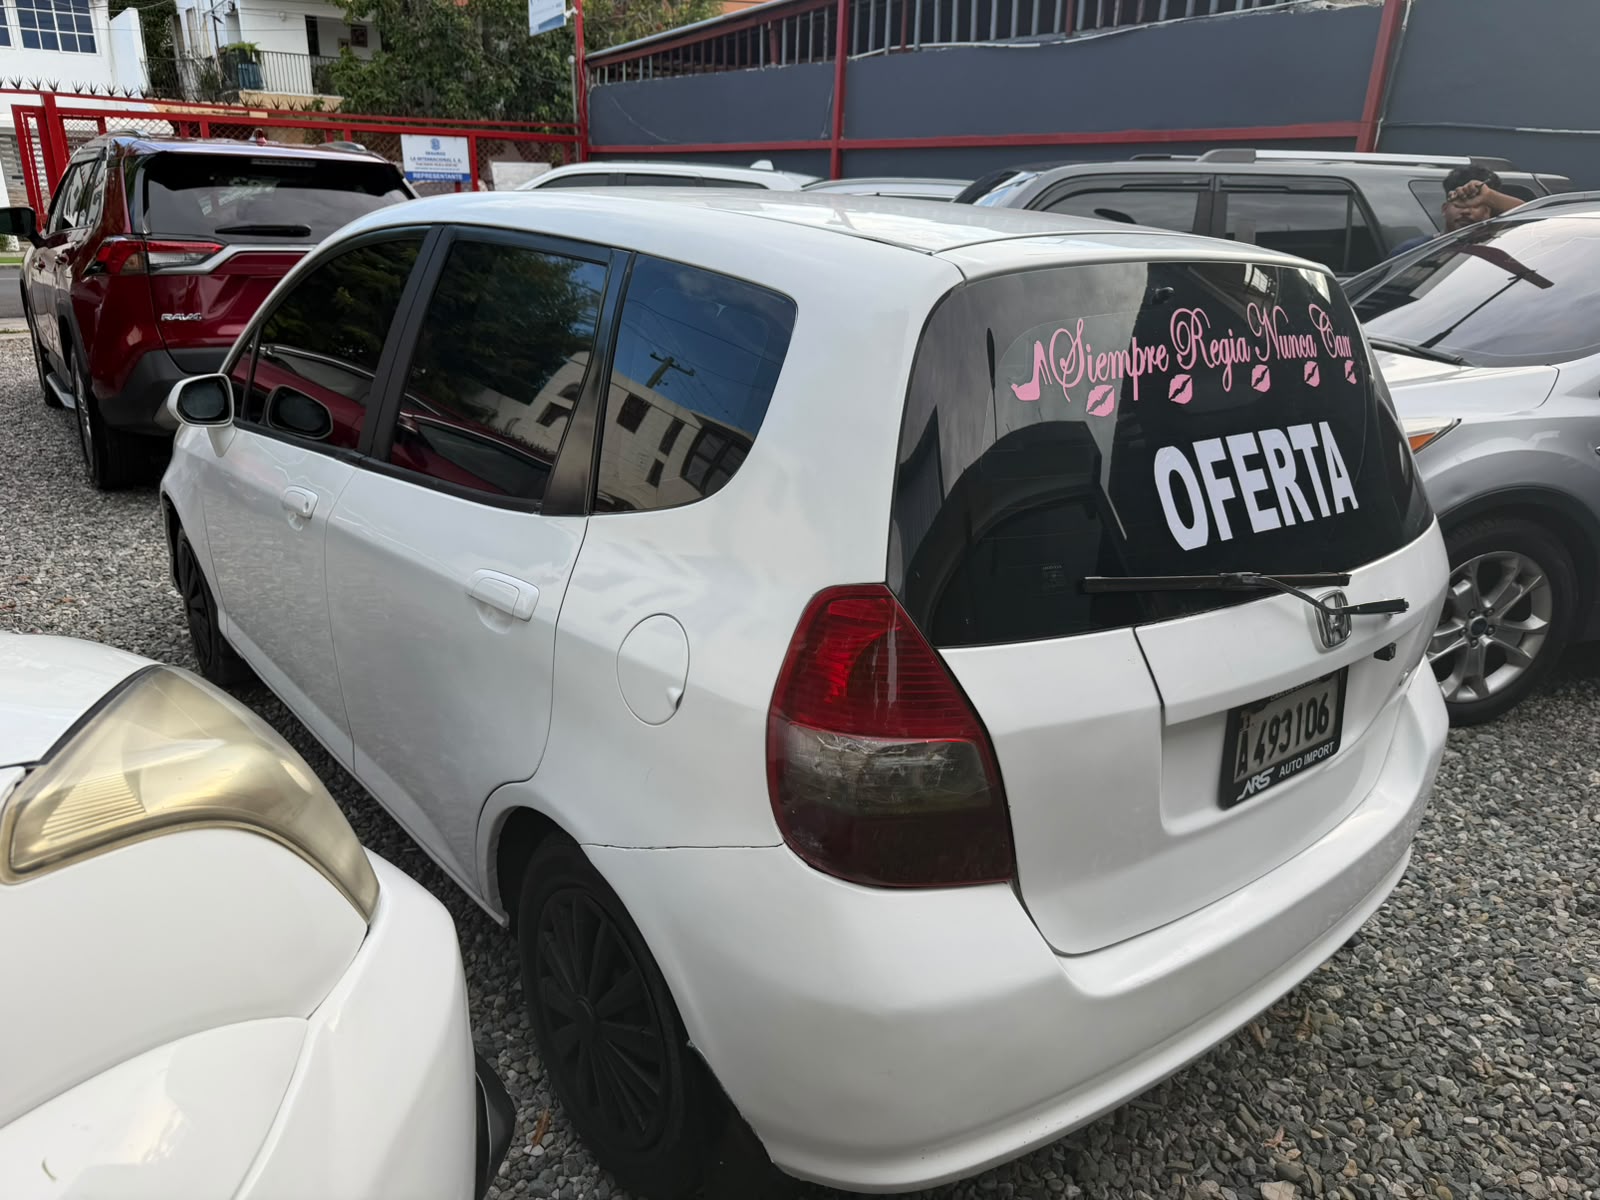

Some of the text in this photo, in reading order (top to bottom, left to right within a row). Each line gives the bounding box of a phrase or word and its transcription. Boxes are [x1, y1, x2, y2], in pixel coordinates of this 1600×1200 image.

[1049, 318, 1169, 402] Siempre
[1170, 308, 1250, 392] Regia
[1247, 302, 1317, 361] Nunca
[1154, 421, 1359, 551] OFERTA
[1279, 757, 1303, 778] AUTO
[1303, 741, 1335, 767] IMPORT
